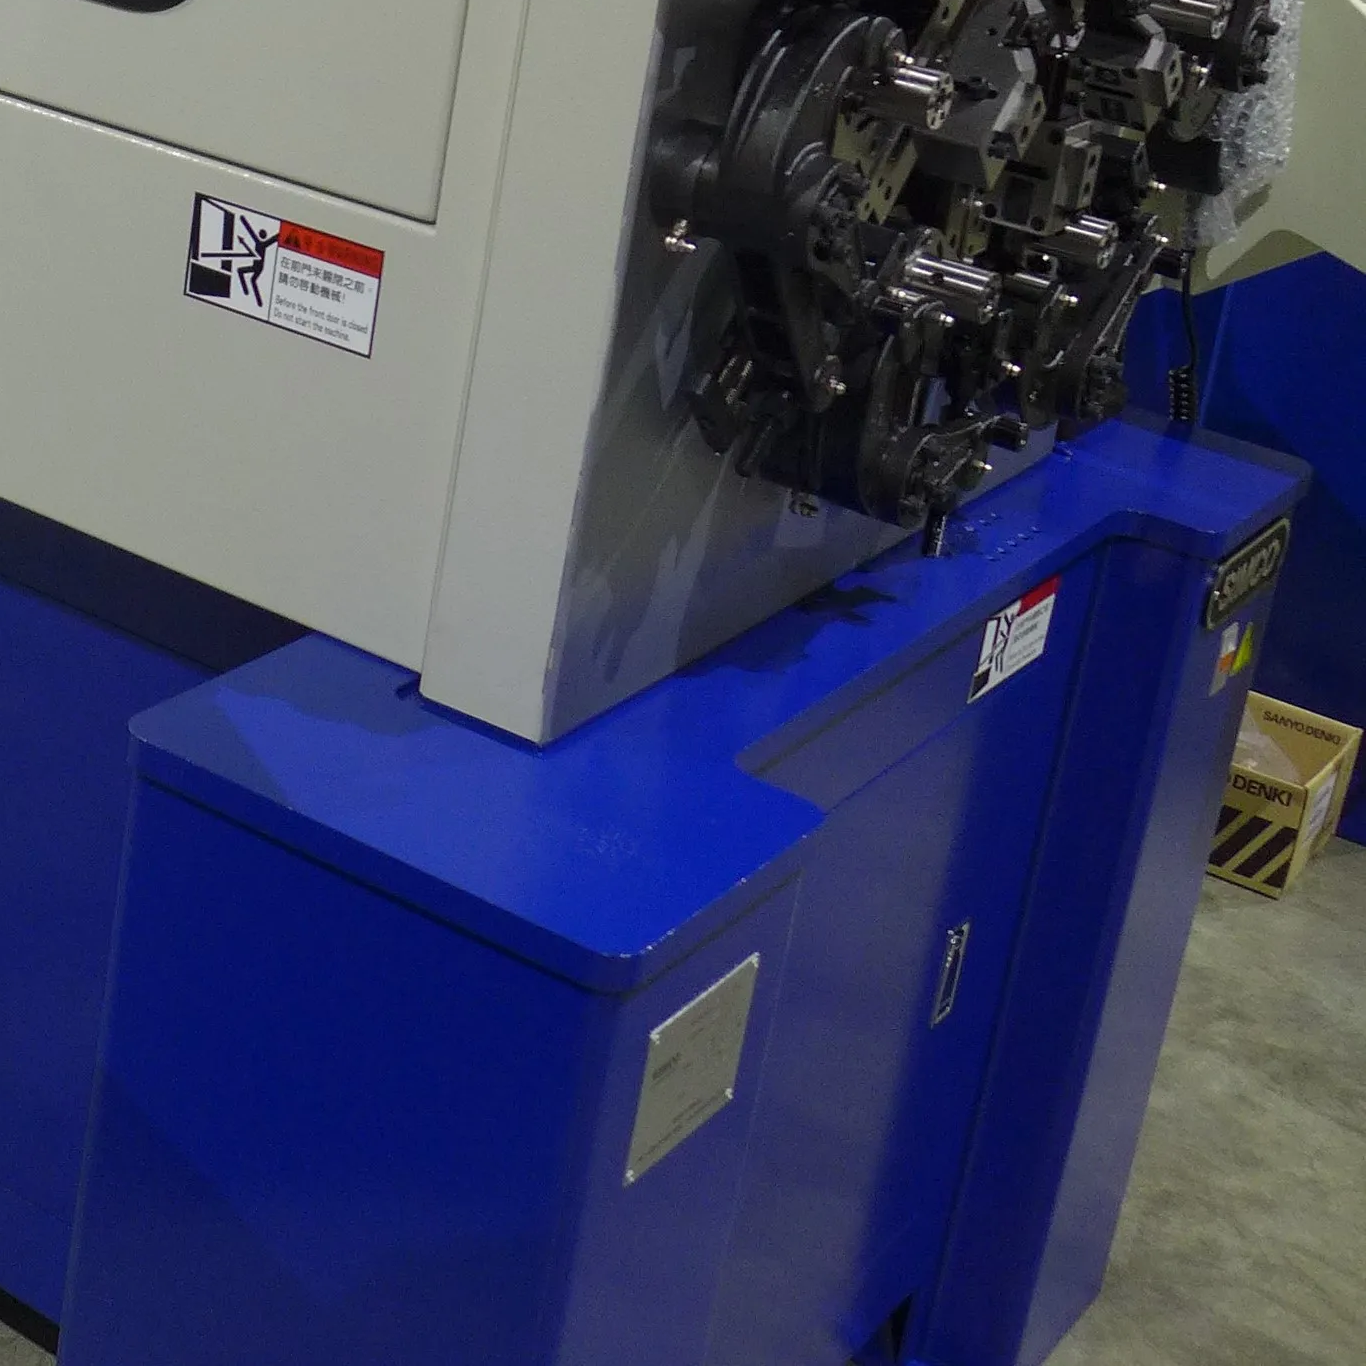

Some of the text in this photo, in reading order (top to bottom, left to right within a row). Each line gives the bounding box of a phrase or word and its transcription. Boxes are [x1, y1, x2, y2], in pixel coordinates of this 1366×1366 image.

[275, 294, 297, 310] Before
[326, 311, 340, 324] door
[348, 319, 369, 334] closed
[1263, 710, 1342, 747] SANYO DENKI
[1232, 773, 1293, 808] DENKI
